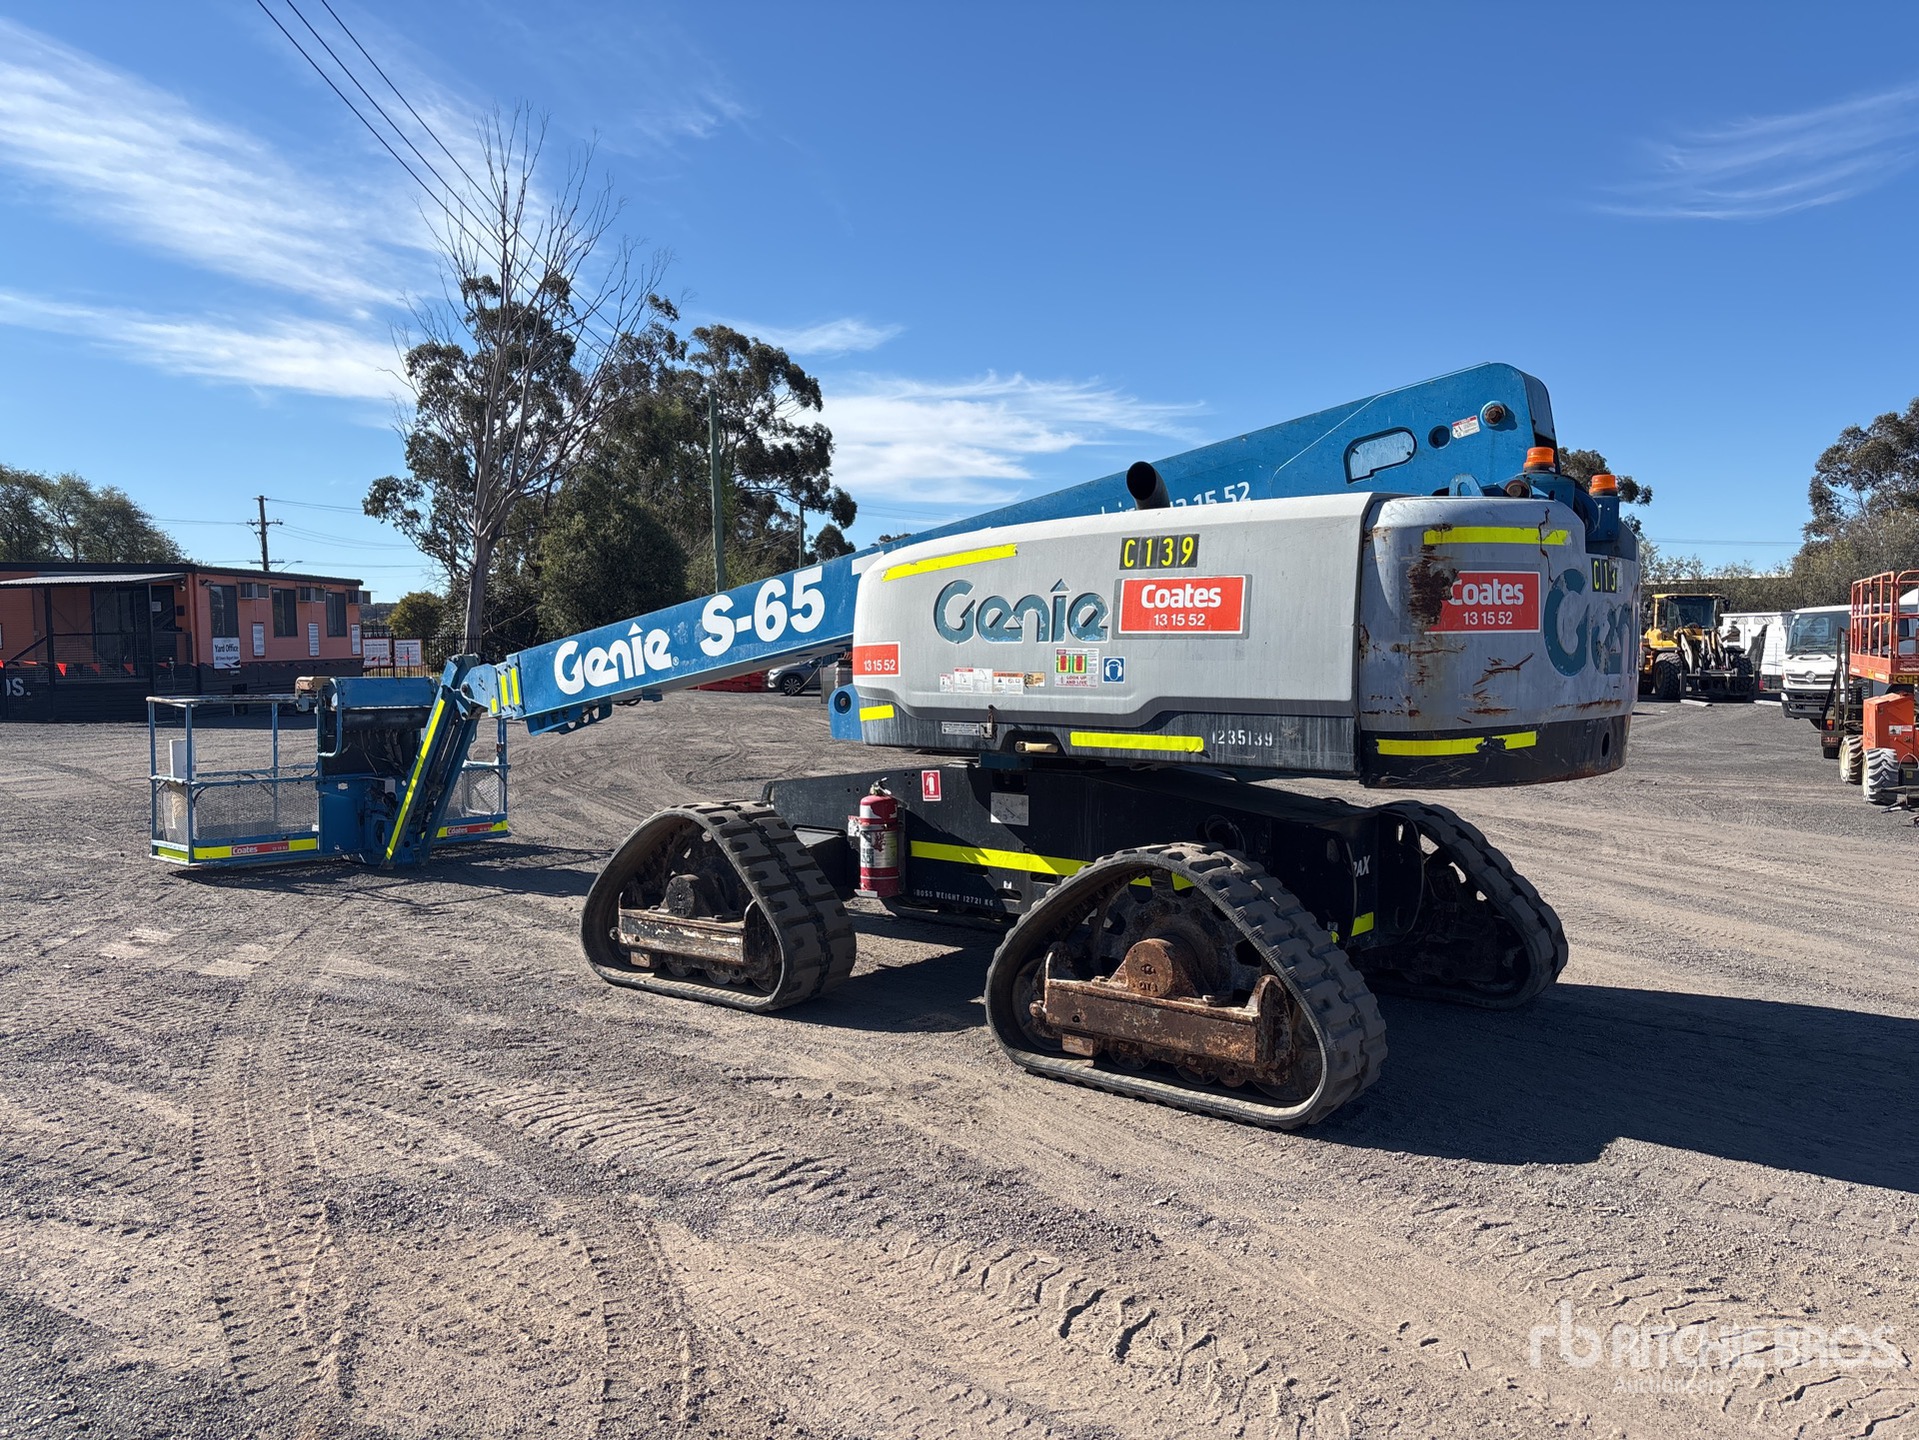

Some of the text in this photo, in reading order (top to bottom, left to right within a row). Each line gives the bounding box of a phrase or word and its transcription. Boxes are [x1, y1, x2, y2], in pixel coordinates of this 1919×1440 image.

[1224, 481, 1251, 503] 52
[1124, 537, 1194, 567] C139
[1141, 583, 1222, 609] Coates
[1448, 579, 1525, 605] Coates
[700, 565, 826, 657] S-65
[933, 578, 1110, 644] Genie
[1153, 613, 1206, 626] 13 15 52
[1463, 611, 1513, 625] 13 15 52
[214, 643, 239, 653] Yard Office
[554, 622, 673, 695] Genie
[864, 659, 896, 672] 13 15 52
[1211, 729, 1274, 747] 1235139
[232, 846, 258, 855] Coates
[936, 891, 960, 901] WEIGHT
[963, 895, 981, 905] 12721
[984, 898, 994, 907] KG
